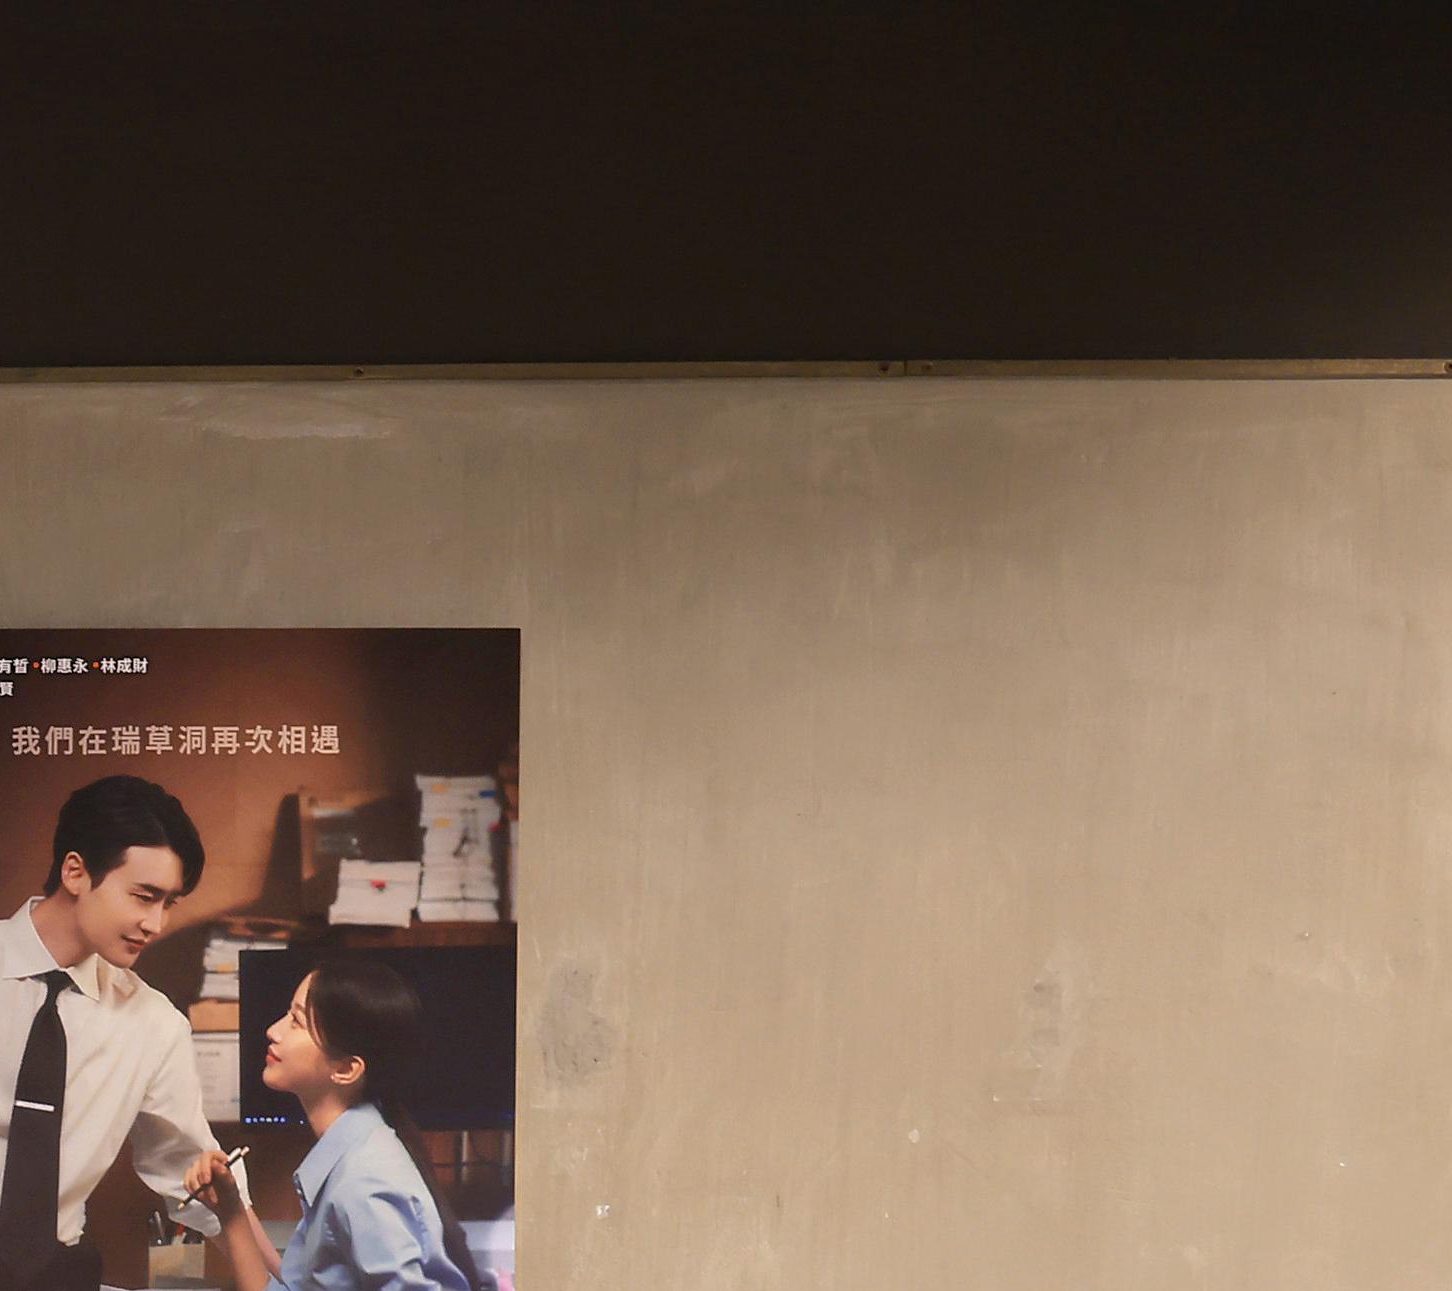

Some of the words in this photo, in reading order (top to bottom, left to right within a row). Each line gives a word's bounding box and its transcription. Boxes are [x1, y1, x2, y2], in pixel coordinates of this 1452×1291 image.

[11, 725, 340, 756] 我們在瑞草洞再次相遇
